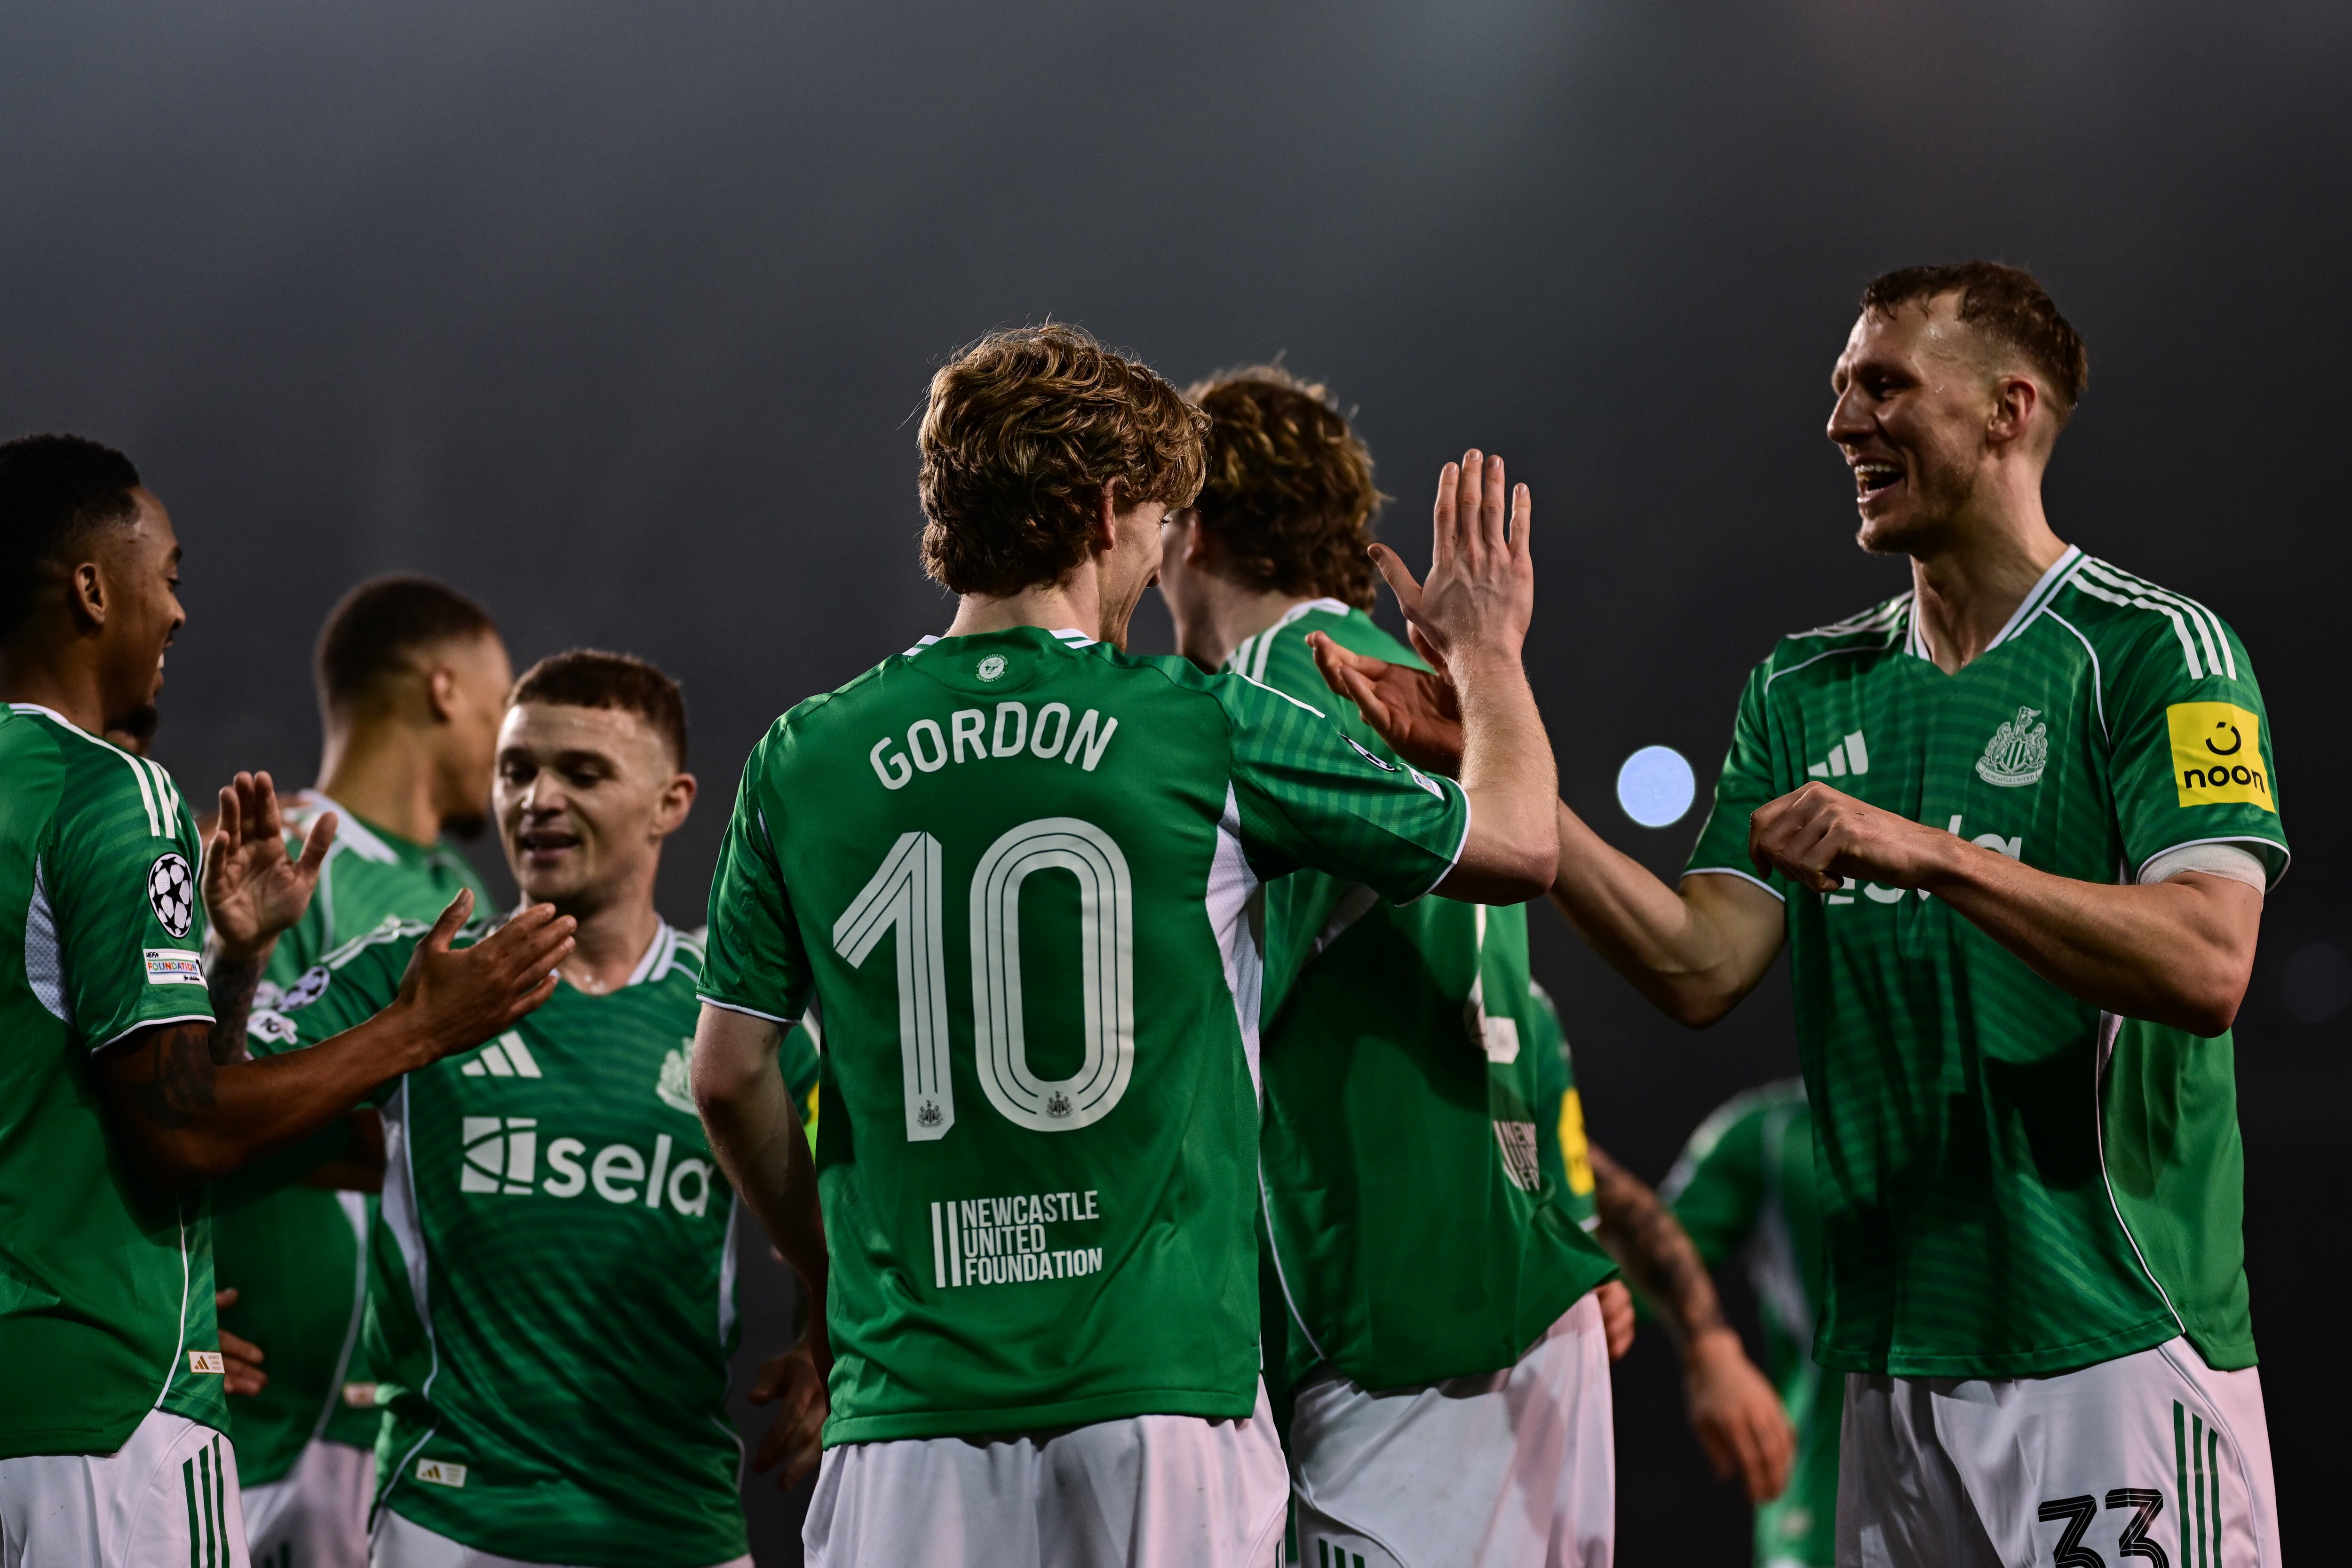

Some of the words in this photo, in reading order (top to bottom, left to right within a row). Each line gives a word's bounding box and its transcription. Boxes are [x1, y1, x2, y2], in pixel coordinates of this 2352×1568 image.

[976, 673, 994, 682] FOOTBALL
[995, 671, 1005, 680] CLUB
[869, 701, 1119, 791] GORDON
[2013, 774, 2035, 783] UNITED
[2184, 766, 2265, 794] noon
[148, 962, 197, 971] FOUNDATION
[833, 816, 1135, 1142] 10
[543, 1133, 715, 1217] sela
[961, 1190, 1099, 1228] NEWCASTLE
[963, 1223, 1046, 1258] UNITED
[965, 1247, 1103, 1286] FOUNDATION
[2037, 1488, 2169, 1568] 33
